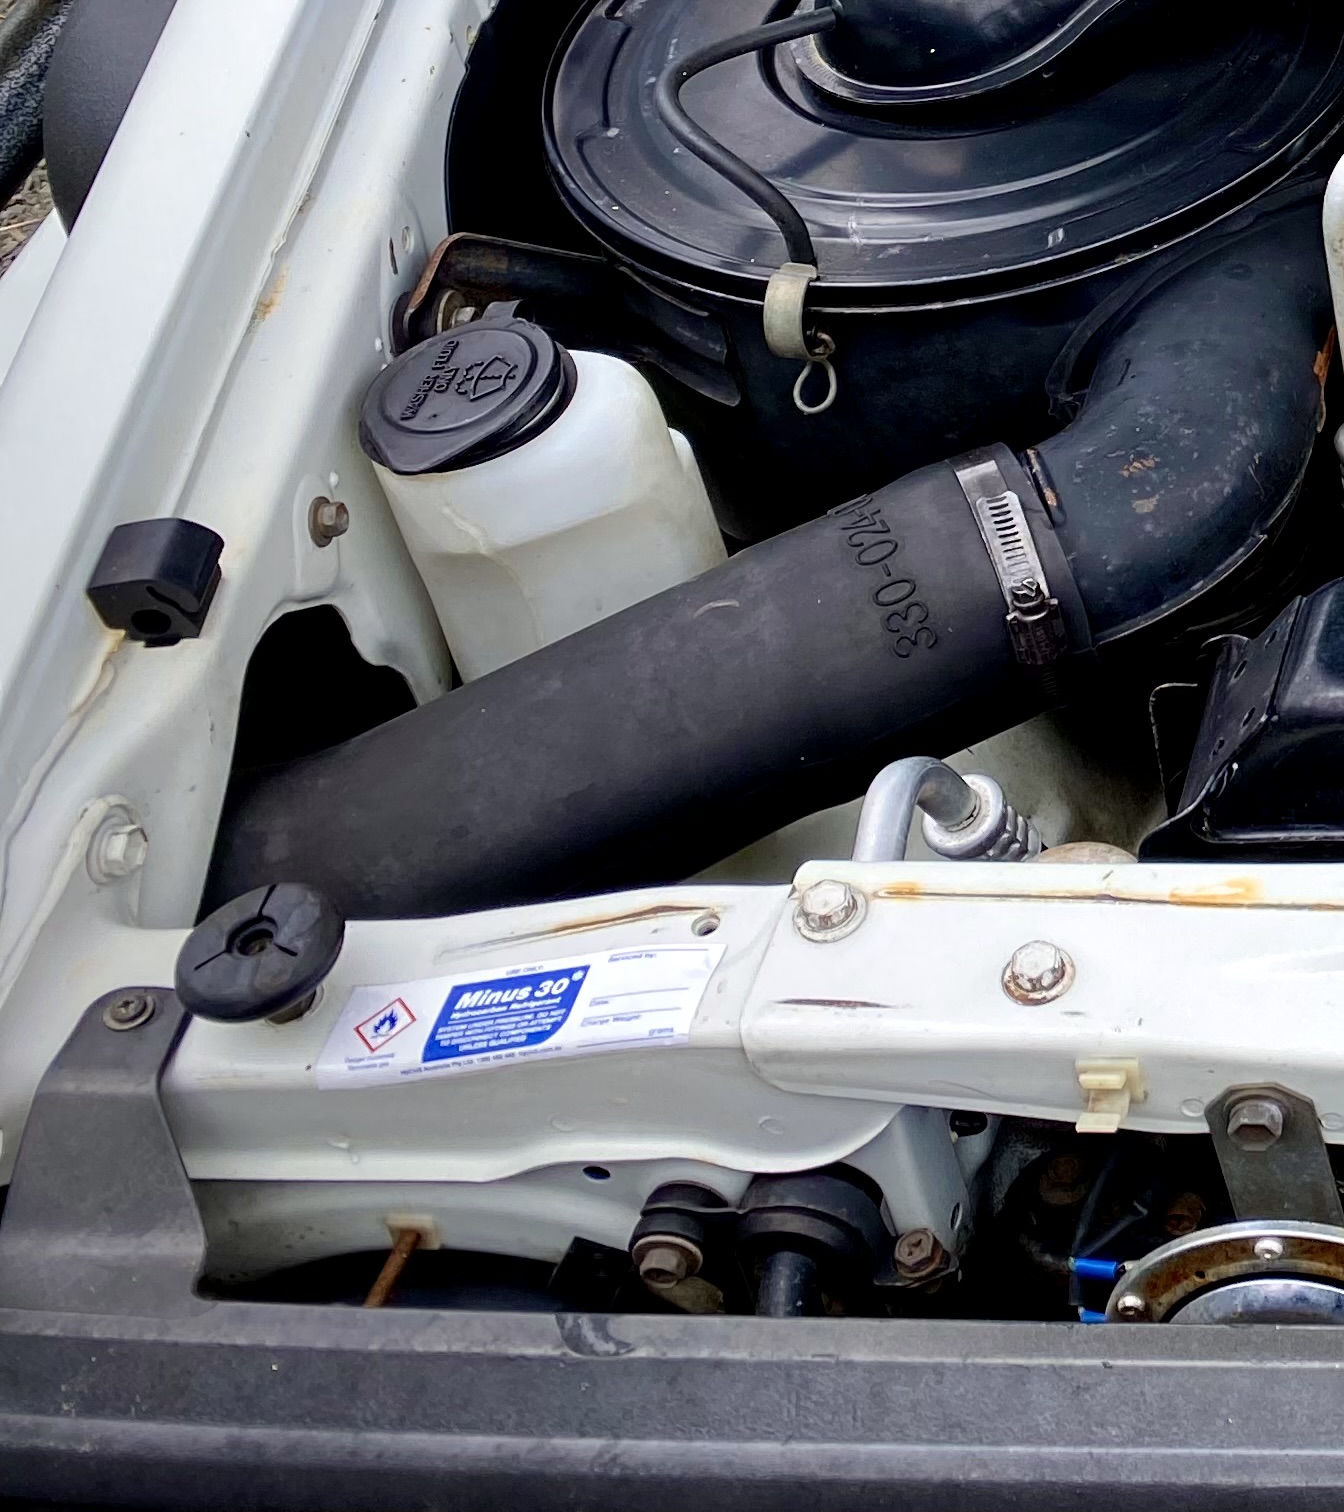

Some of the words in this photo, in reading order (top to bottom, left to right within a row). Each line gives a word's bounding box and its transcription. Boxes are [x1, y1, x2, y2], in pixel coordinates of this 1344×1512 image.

[400, 374, 440, 420] WASHER
[431, 340, 459, 370] FLUID
[433, 364, 460, 393] ONLY
[454, 985, 533, 1010] Minus
[534, 977, 570, 998] 30
